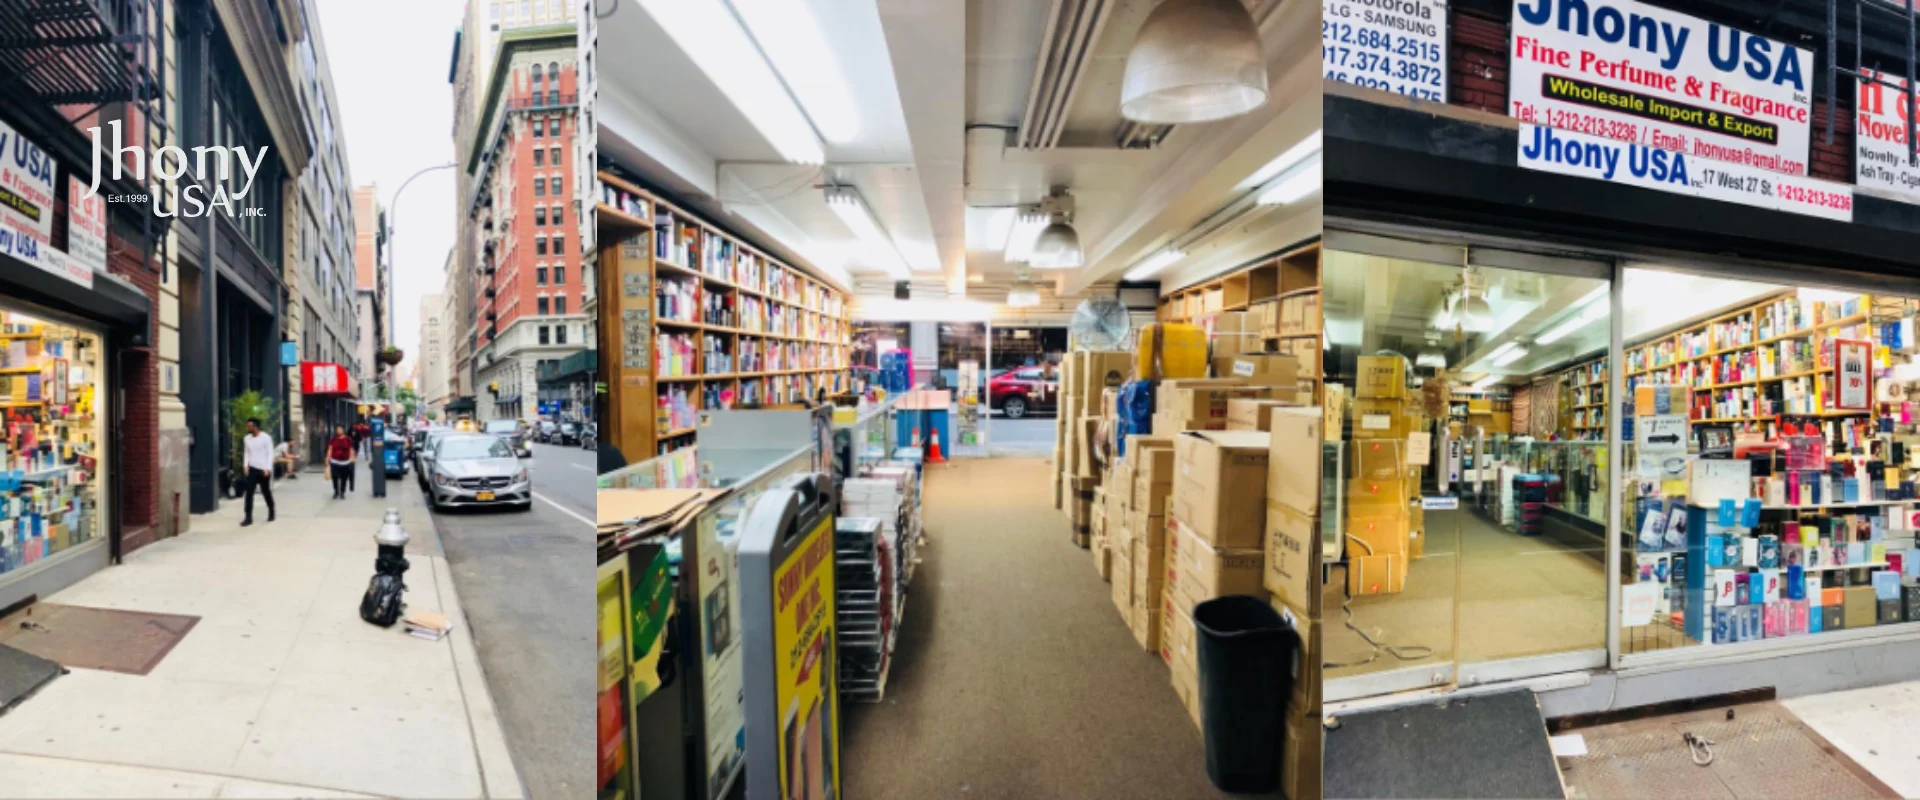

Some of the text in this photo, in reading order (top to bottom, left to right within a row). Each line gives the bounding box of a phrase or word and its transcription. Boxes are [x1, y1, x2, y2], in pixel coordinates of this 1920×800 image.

[1330, 3, 1350, 17] LG
[1364, 10, 1436, 37] SAMSUNG
[1347, 0, 1431, 19] torola
[1323, 45, 1441, 86] 17.374.3872
[1517, 0, 1804, 91] Jhony USA
[1516, 35, 1808, 124] Fine Perfume & Fragrance
[1513, 101, 1538, 123] Tel:
[1546, 108, 1637, 142] 1-212-213-3236
[1653, 129, 1688, 152] Email:
[1550, 77, 1773, 140] Wholesale Import & Export
[1859, 113, 1920, 153] Novel
[14, 132, 52, 187] USA
[1523, 126, 1620, 180] Jhony
[1629, 143, 1688, 186] USA
[1703, 168, 1715, 185] 17
[1717, 171, 1743, 191] West
[1746, 177, 1758, 193] 27
[1777, 184, 1851, 211] 1-212-213-3236
[1860, 147, 1899, 167] Novelty
[1860, 163, 1875, 179] Ash
[1878, 167, 1895, 185] Tray
